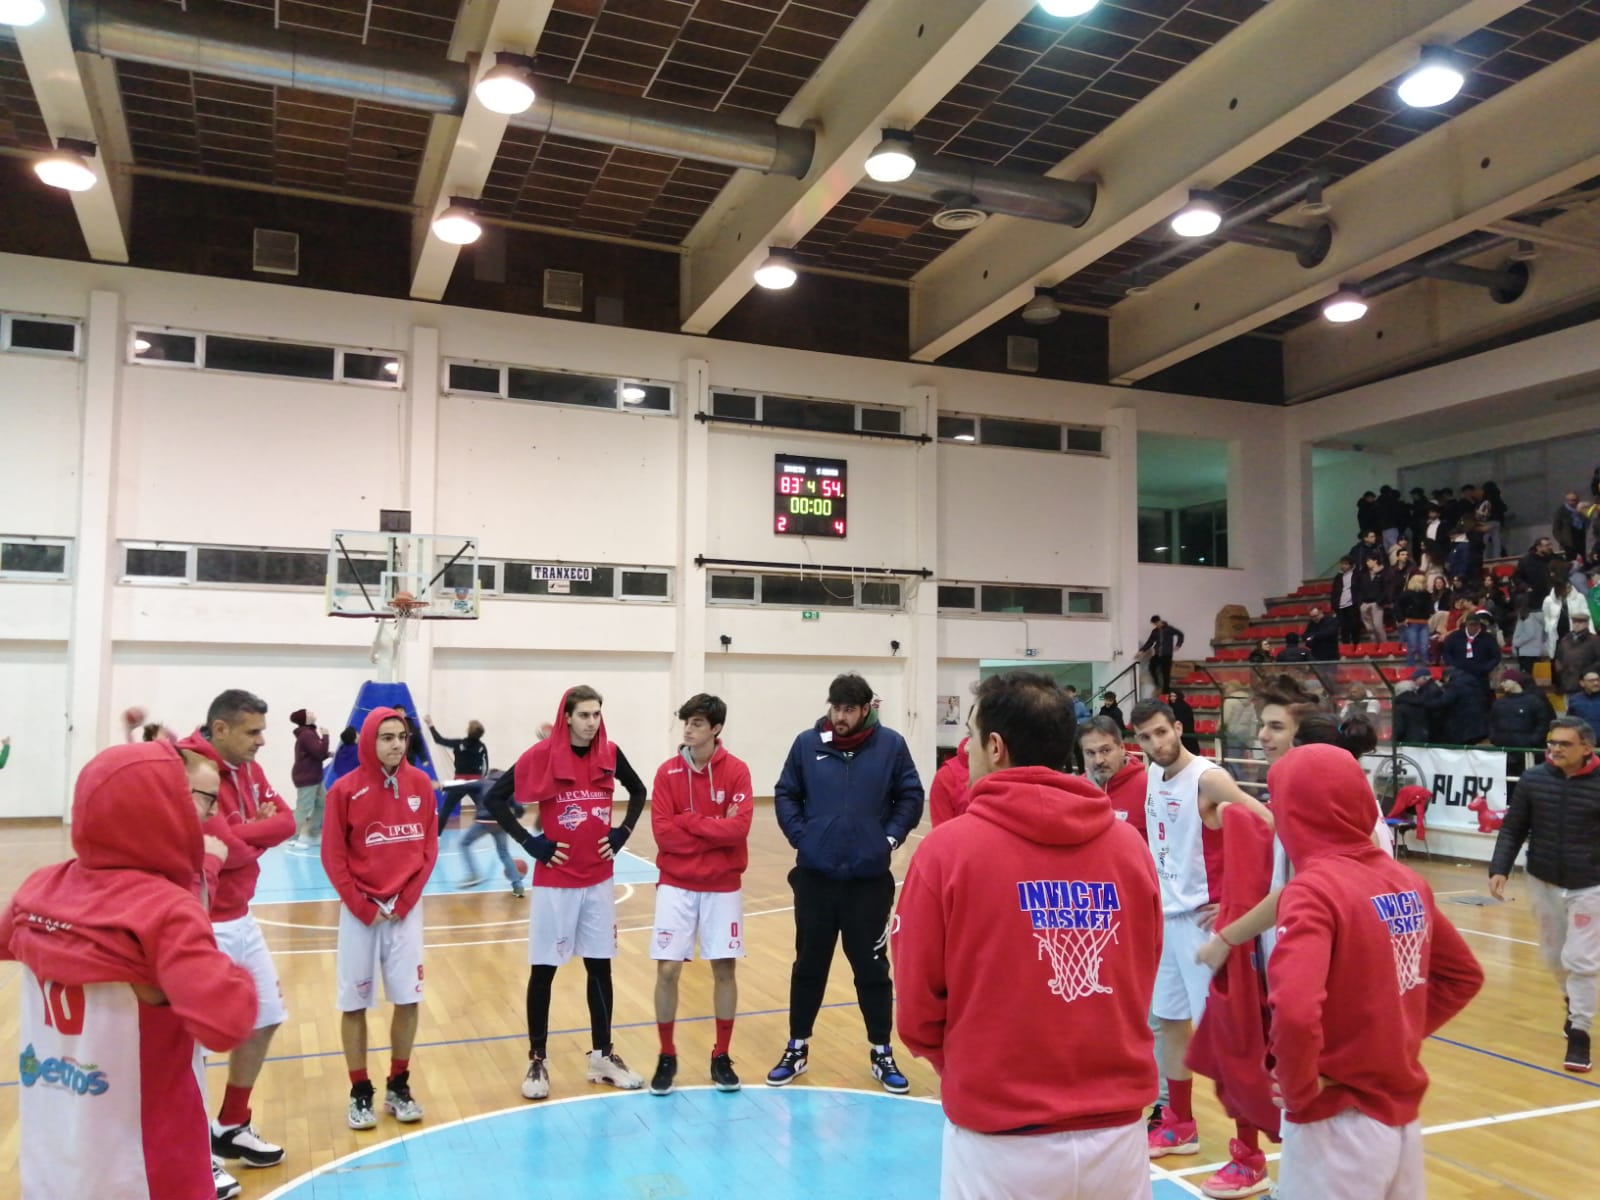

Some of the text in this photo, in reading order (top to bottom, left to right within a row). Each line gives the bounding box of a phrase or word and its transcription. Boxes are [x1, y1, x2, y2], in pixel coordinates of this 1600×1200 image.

[780, 476, 800, 494] 83
[807, 480, 816, 493] 4
[822, 480, 841, 497] 54
[790, 497, 832, 516] 00:00
[777, 516, 787, 531] 2
[834, 521, 844, 534] 4
[534, 566, 590, 580] TRANXECO
[1431, 774, 1493, 807] PLAY
[1158, 822, 1165, 840] 9
[1017, 880, 1121, 911] INVICTA
[1030, 909, 1112, 931] BASKET
[731, 922, 738, 938] 0
